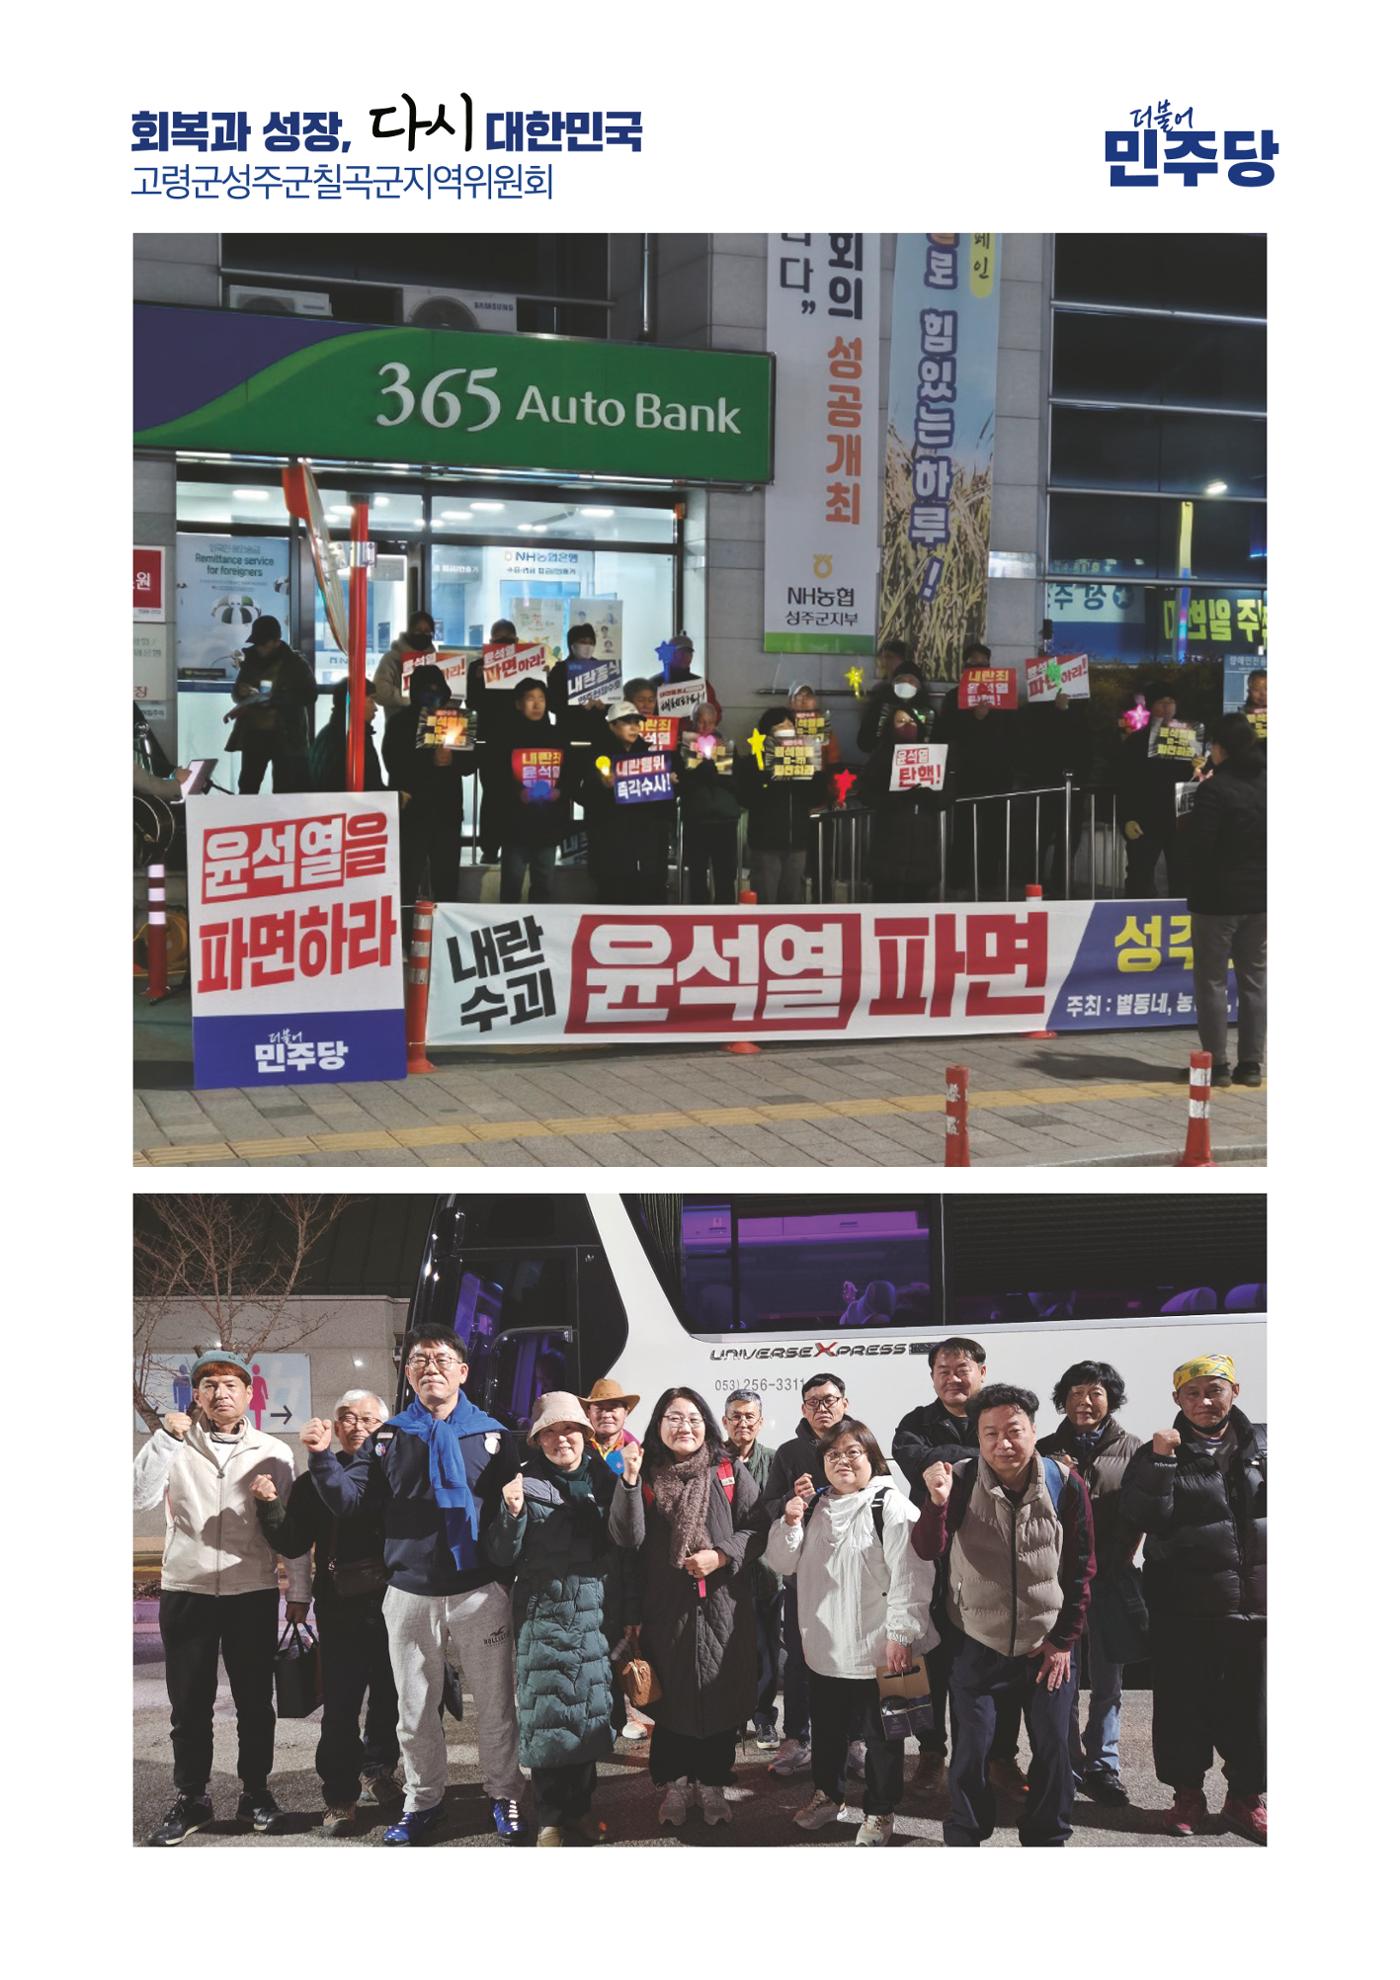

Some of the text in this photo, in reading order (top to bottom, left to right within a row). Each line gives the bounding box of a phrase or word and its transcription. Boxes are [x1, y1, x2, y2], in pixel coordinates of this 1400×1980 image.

[474, 301, 514, 312] SAMSUNG
[915, 308, 959, 448] 힘있는
[375, 362, 742, 435] 365 Auto Bank
[826, 336, 863, 525] 성공개최
[195, 552, 274, 567] Remittance service
[206, 566, 263, 579] for foreigners
[787, 586, 854, 607] NH농협
[785, 610, 858, 627] 성주군지부
[483, 646, 546, 684] 파면하라!
[968, 670, 1009, 682] 내란죄
[521, 752, 562, 765] 내란죄
[615, 754, 665, 777] 내란행위
[617, 772, 672, 800] 즉각수사!
[898, 765, 942, 788] 탄핵!
[204, 812, 388, 900] 윤석열을
[197, 895, 397, 994] 파면하라
[447, 914, 545, 984] 내란
[585, 911, 1049, 1024] 윤석열 파면
[460, 968, 556, 1033] 수괴
[1066, 994, 1102, 1019] 주최
[1116, 992, 1173, 1017] 별동네,
[1177, 992, 1198, 1013] 농
[267, 1028, 303, 1044] 더불어
[254, 1040, 349, 1073] 민주당
